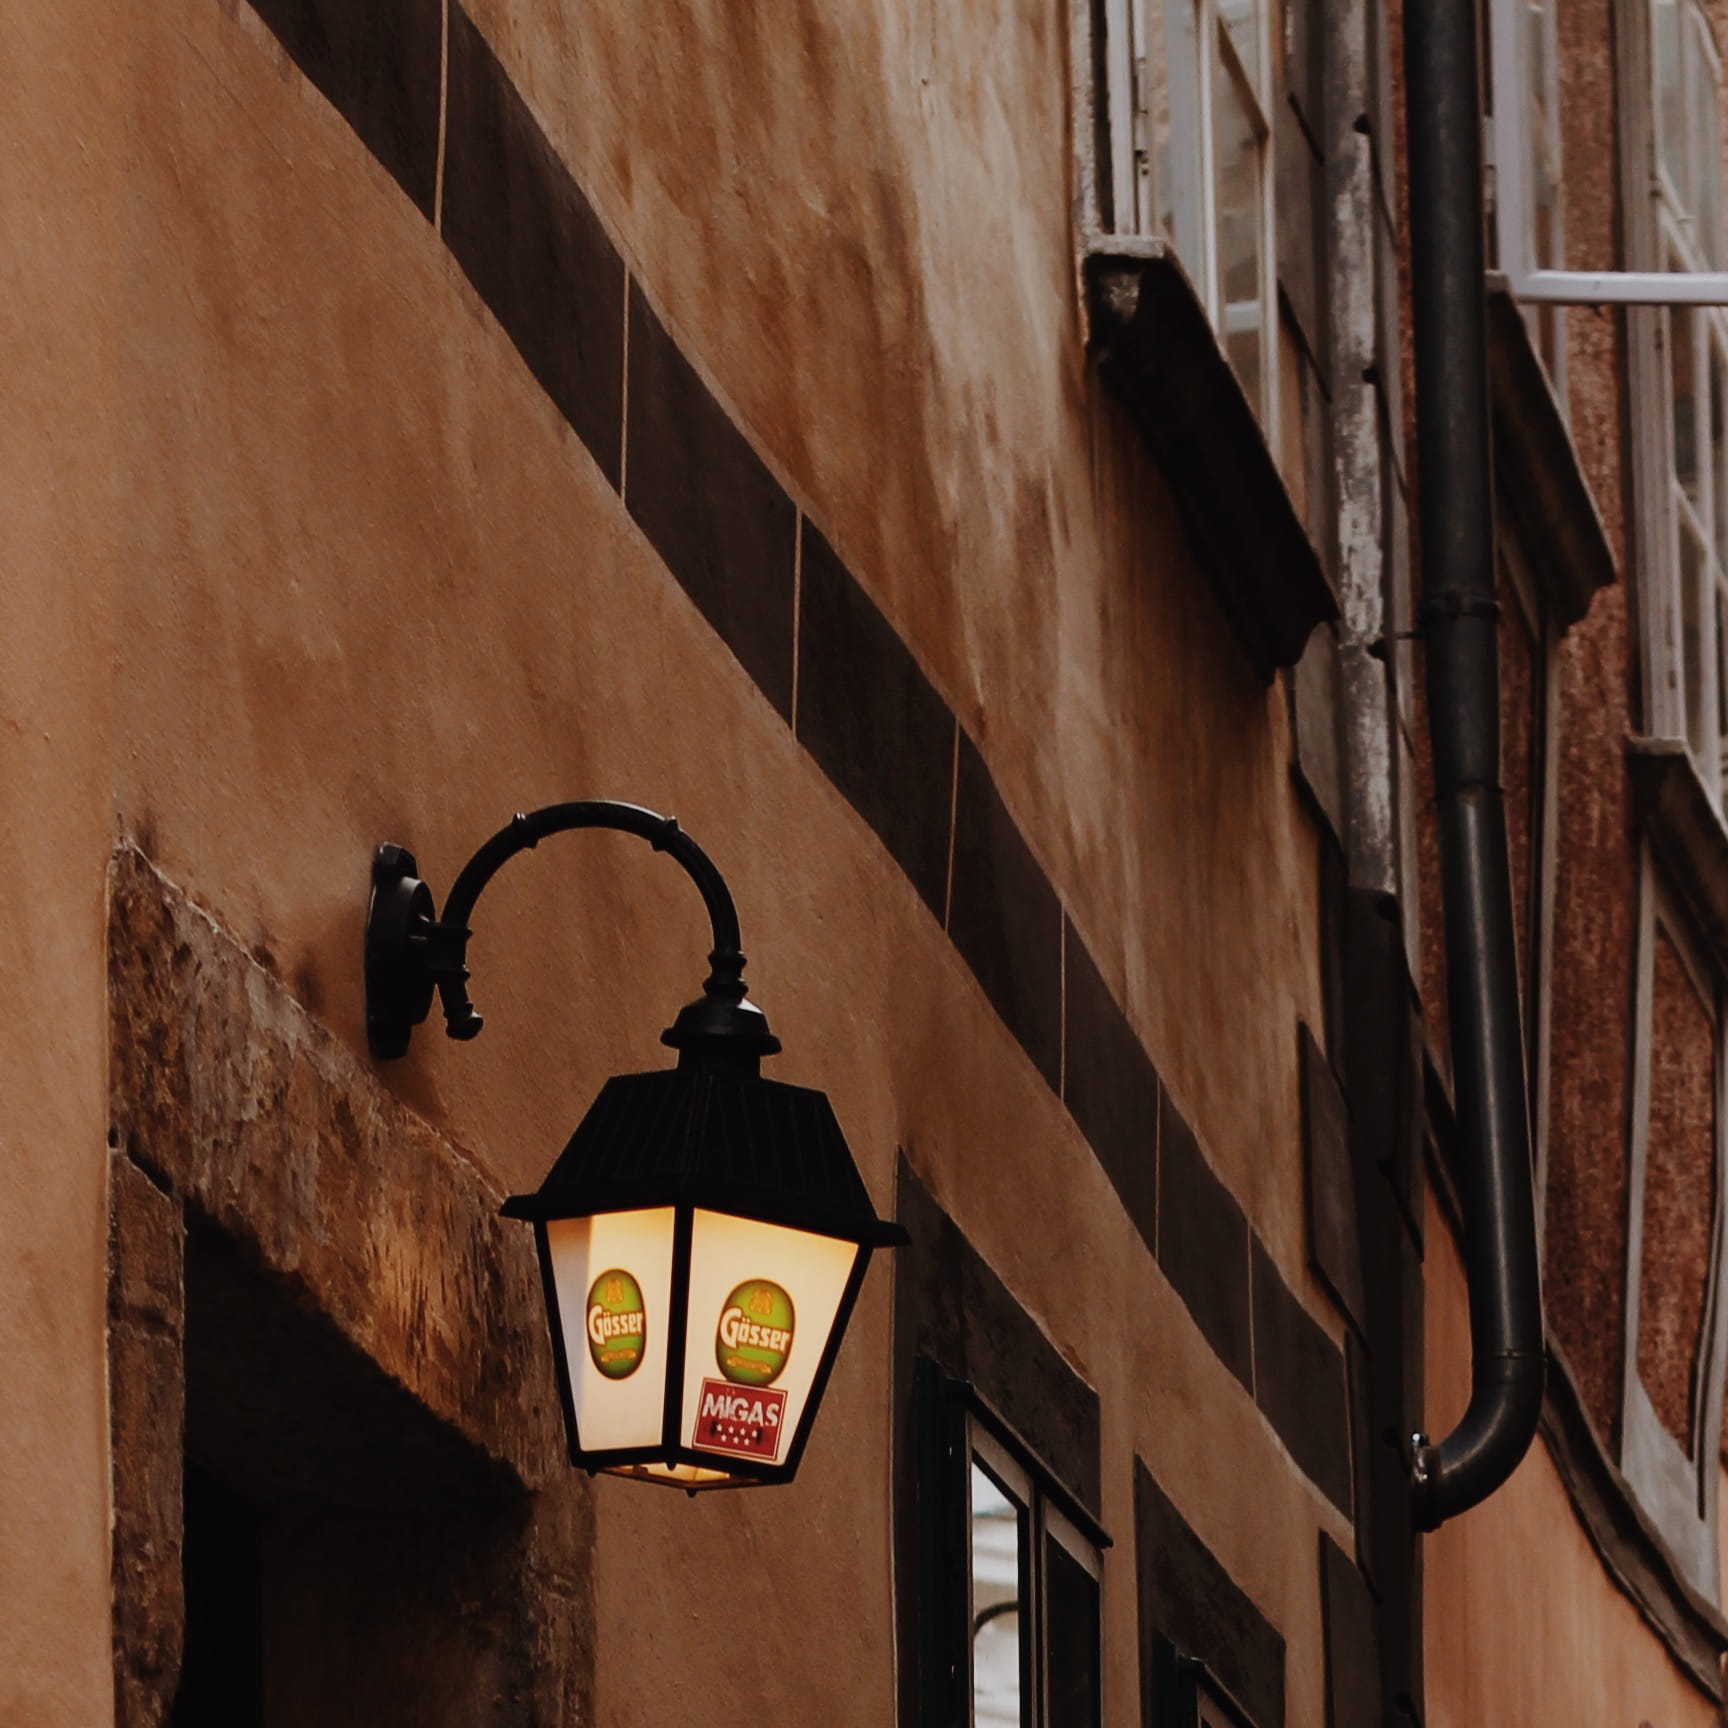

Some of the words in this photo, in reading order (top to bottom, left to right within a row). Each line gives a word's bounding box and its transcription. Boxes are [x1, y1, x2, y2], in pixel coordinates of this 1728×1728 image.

[588, 1304, 643, 1345] Gösser
[720, 1307, 791, 1352] Gösser
[702, 1392, 780, 1428] MIGAS
